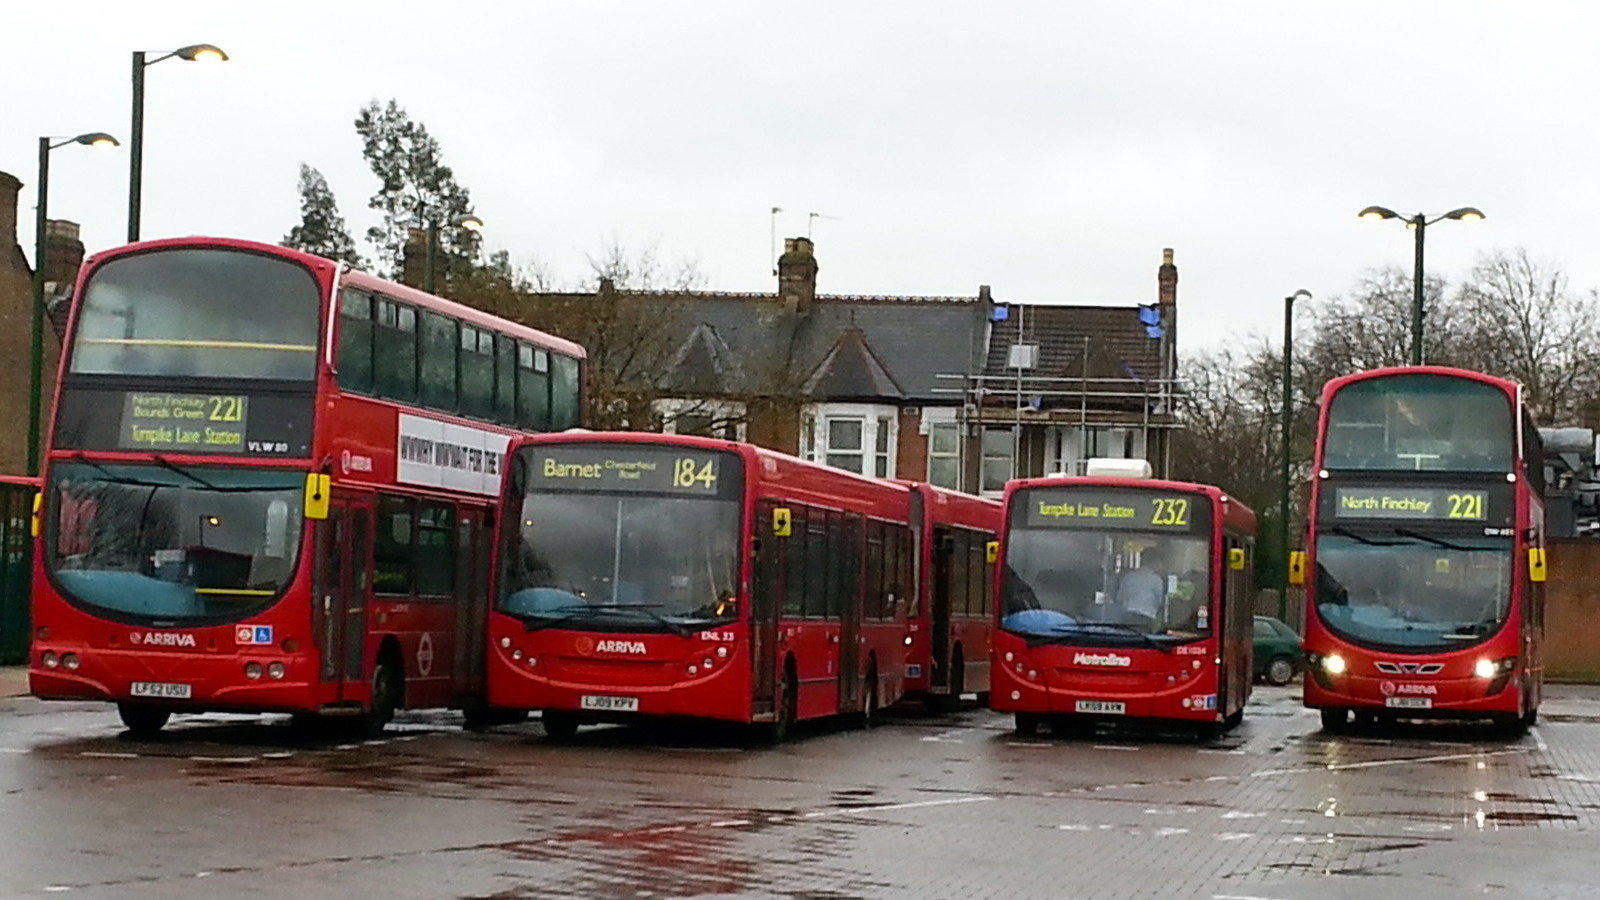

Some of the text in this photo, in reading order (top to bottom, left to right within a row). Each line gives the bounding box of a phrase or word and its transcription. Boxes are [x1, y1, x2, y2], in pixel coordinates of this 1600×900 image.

[173, 407, 204, 419] Green
[209, 396, 243, 421] 221
[132, 424, 241, 446] Turnpike Lane Station
[543, 457, 602, 478] Barnet
[673, 457, 717, 489] 184
[1039, 501, 1136, 519] Turnpike Lane Station
[1151, 498, 1188, 526] 232
[1341, 496, 1432, 513] North Finchley
[1447, 494, 1482, 518] 221
[143, 632, 196, 647] ARRIVA
[596, 640, 647, 654] ARRIVA
[1072, 652, 1131, 667] Metroline
[135, 683, 163, 695] LF52
[1397, 684, 1438, 695] ARRIVA
